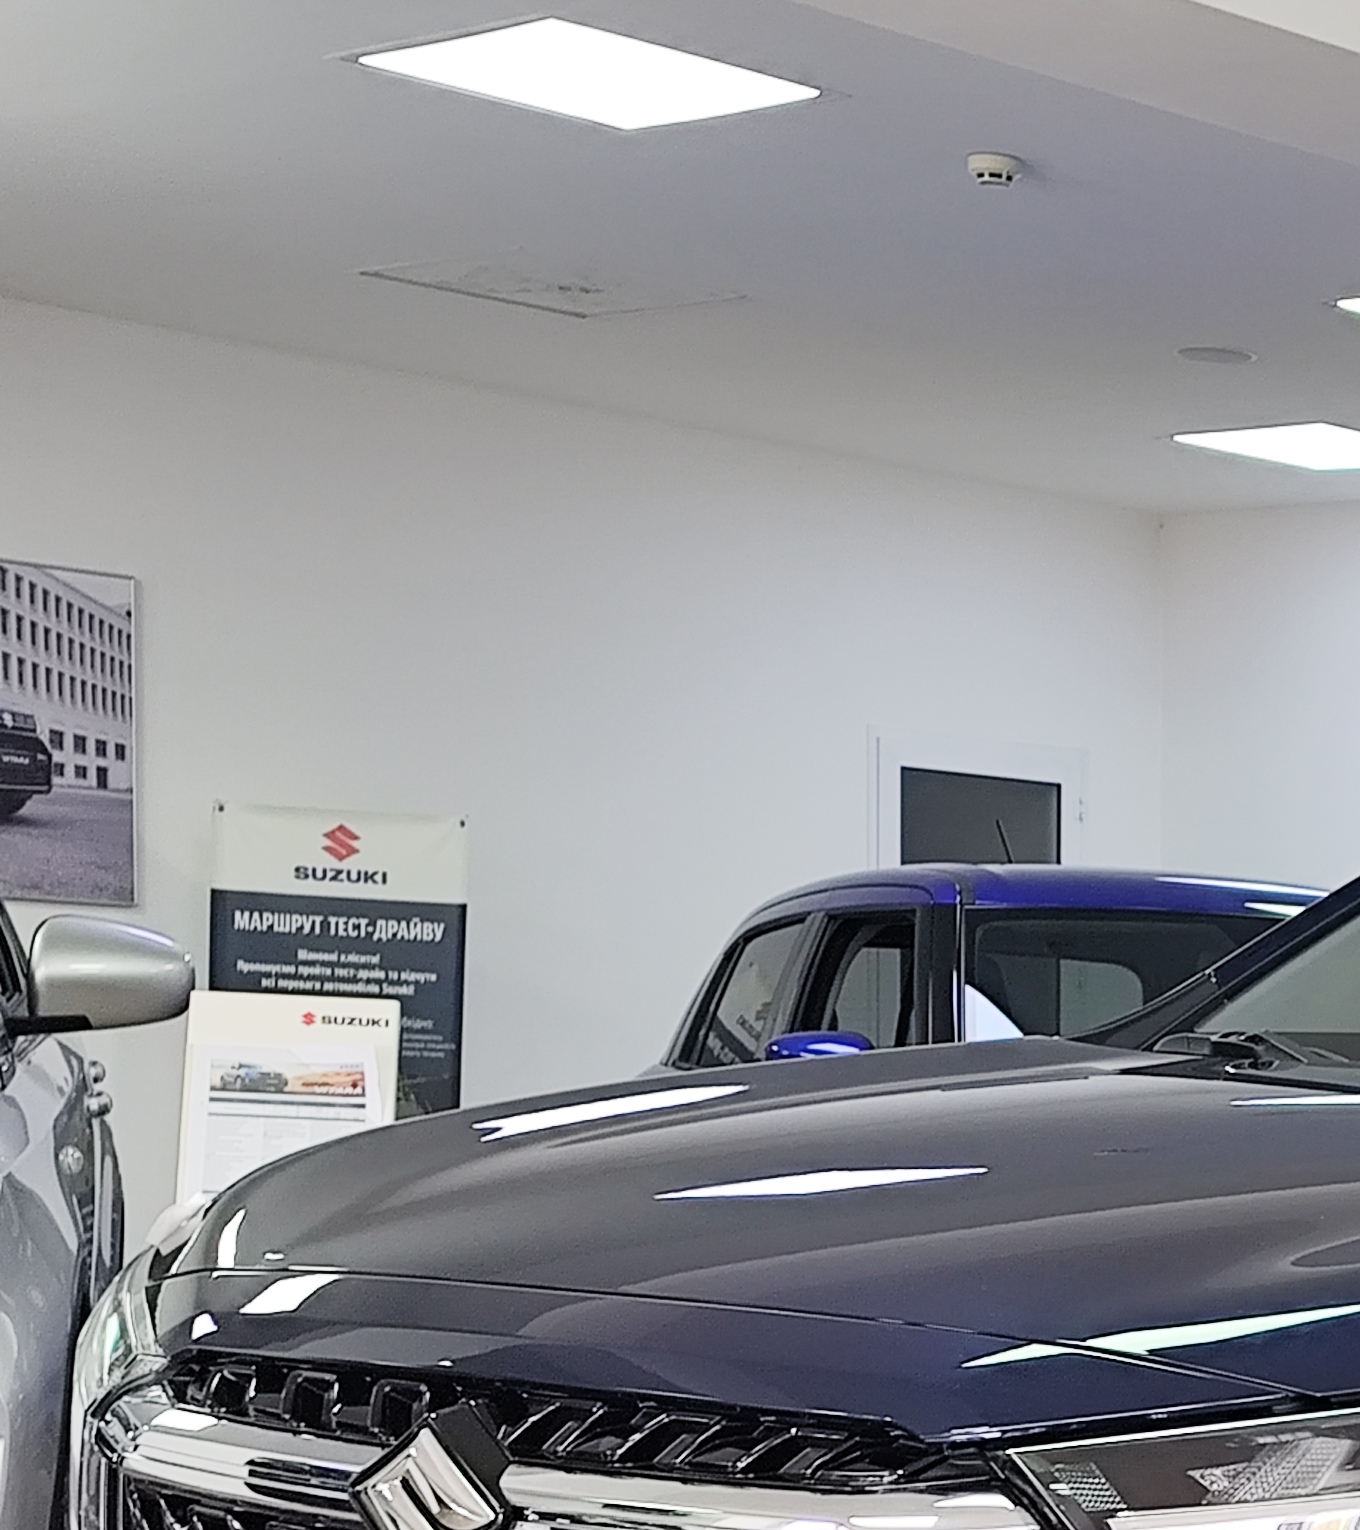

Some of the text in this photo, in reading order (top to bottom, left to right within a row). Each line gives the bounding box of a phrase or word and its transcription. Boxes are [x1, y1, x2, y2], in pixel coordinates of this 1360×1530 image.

[294, 865, 388, 885] SUZUKI
[233, 910, 445, 943] МАРШРУТ ТЕСТ-ДРАЙВУ
[321, 1015, 389, 1028] SUZUKI
